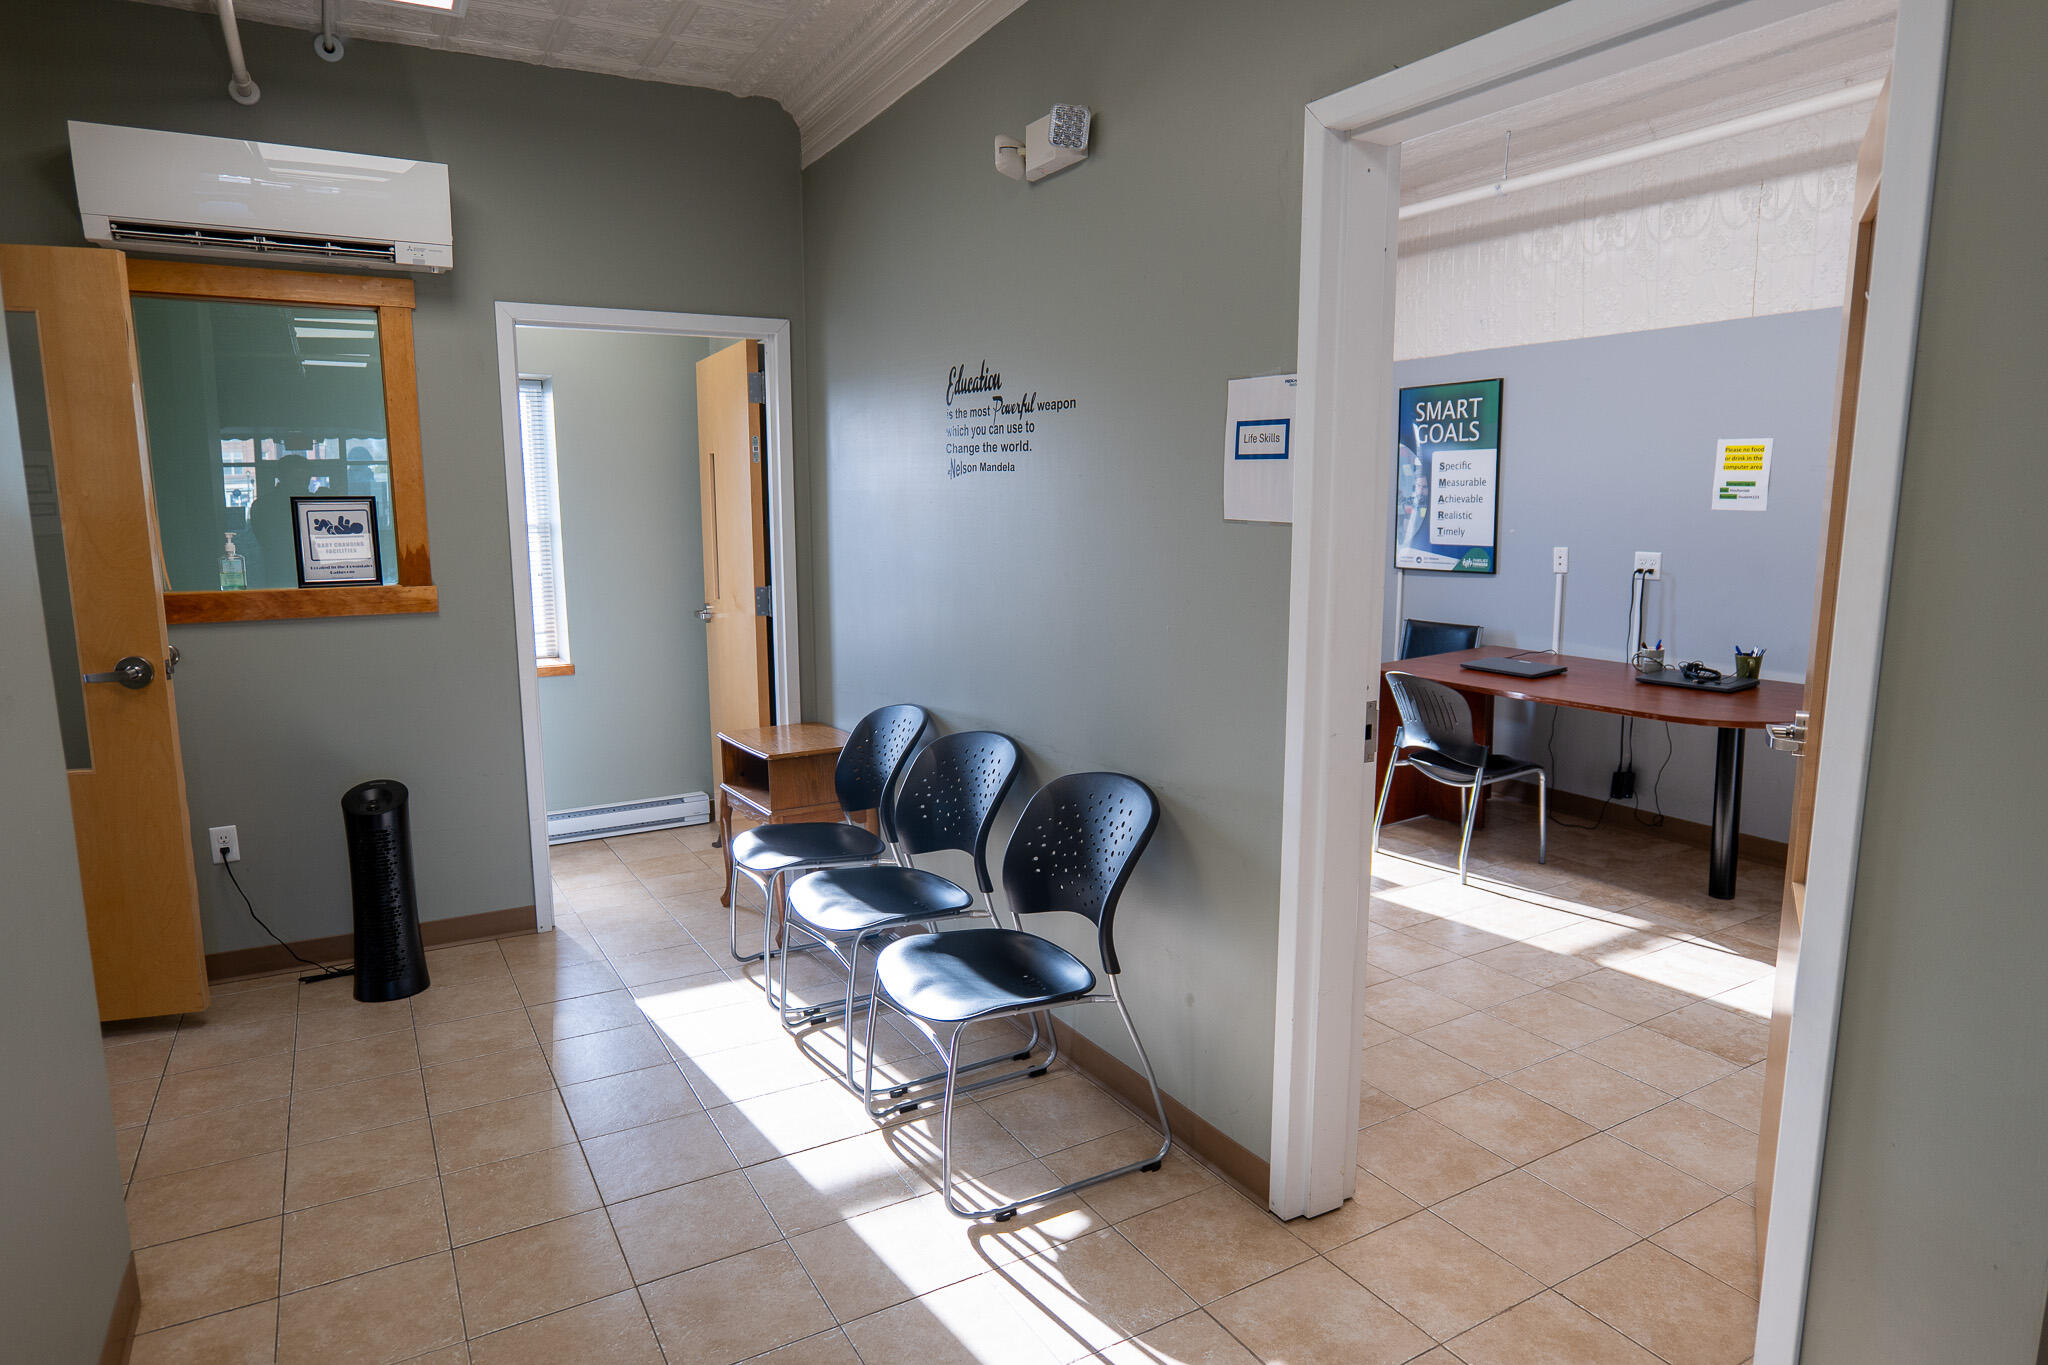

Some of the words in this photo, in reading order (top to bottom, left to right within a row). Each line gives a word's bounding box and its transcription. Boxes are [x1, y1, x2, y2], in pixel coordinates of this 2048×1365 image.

[946, 359, 1002, 406] Education
[946, 409, 953, 419] is
[955, 408, 968, 419] the
[969, 405, 990, 418] most
[992, 391, 1037, 424] Powerful
[1037, 398, 1077, 413] weapon
[1415, 397, 1483, 422] SMART
[946, 424, 969, 437] which
[971, 425, 986, 439] you
[988, 423, 1004, 435] can
[1006, 423, 1023, 434] use
[1025, 421, 1035, 433] to
[1417, 421, 1480, 444] GOALS
[1243, 434, 1258, 444] Life
[1259, 432, 1281, 443] Skills
[946, 443, 980, 455] Change
[982, 441, 998, 453] the
[1000, 440, 1032, 452] world.
[947, 457, 977, 480] Nelson
[980, 461, 1015, 472] Mandela
[1439, 461, 1472, 472] Specific
[1438, 477, 1487, 488] Measurable
[1437, 494, 1483, 504] Achievable
[1437, 511, 1473, 520] Realistic
[1437, 527, 1465, 537] Timely
